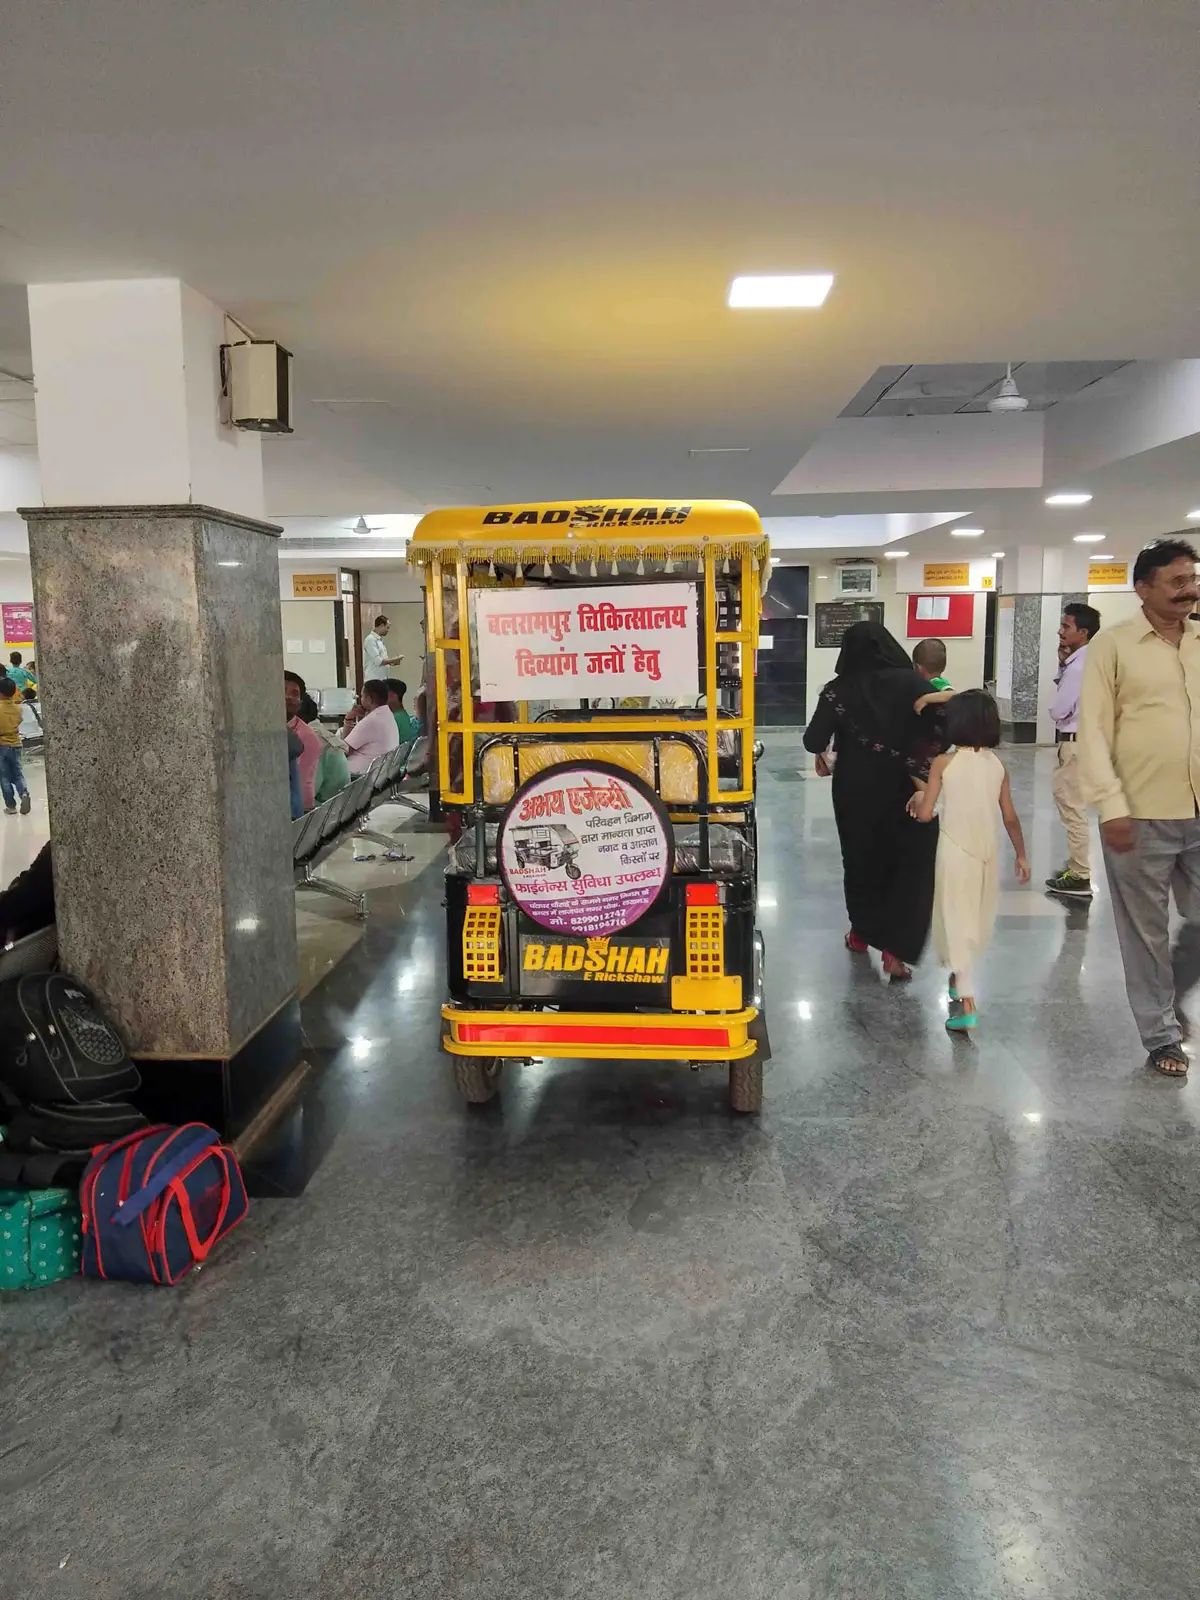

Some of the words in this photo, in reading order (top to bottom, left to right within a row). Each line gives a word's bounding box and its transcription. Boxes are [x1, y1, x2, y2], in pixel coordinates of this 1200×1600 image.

[482, 507, 692, 525] BADSHAH
[486, 611, 571, 642] बलरामपुर
[577, 603, 688, 632] चिकित्सालय
[515, 647, 578, 677] दिव्यांग
[584, 644, 625, 674] जनों
[631, 644, 661, 681] हेतु
[519, 789, 566, 821] अभय
[585, 815, 621, 828] परिवहन
[624, 812, 653, 824] विभाग
[649, 852, 660, 861] पर
[572, 874, 611, 896] सुविधा
[616, 867, 662, 885] उपलब्ध
[523, 943, 670, 974] BADSHAH
